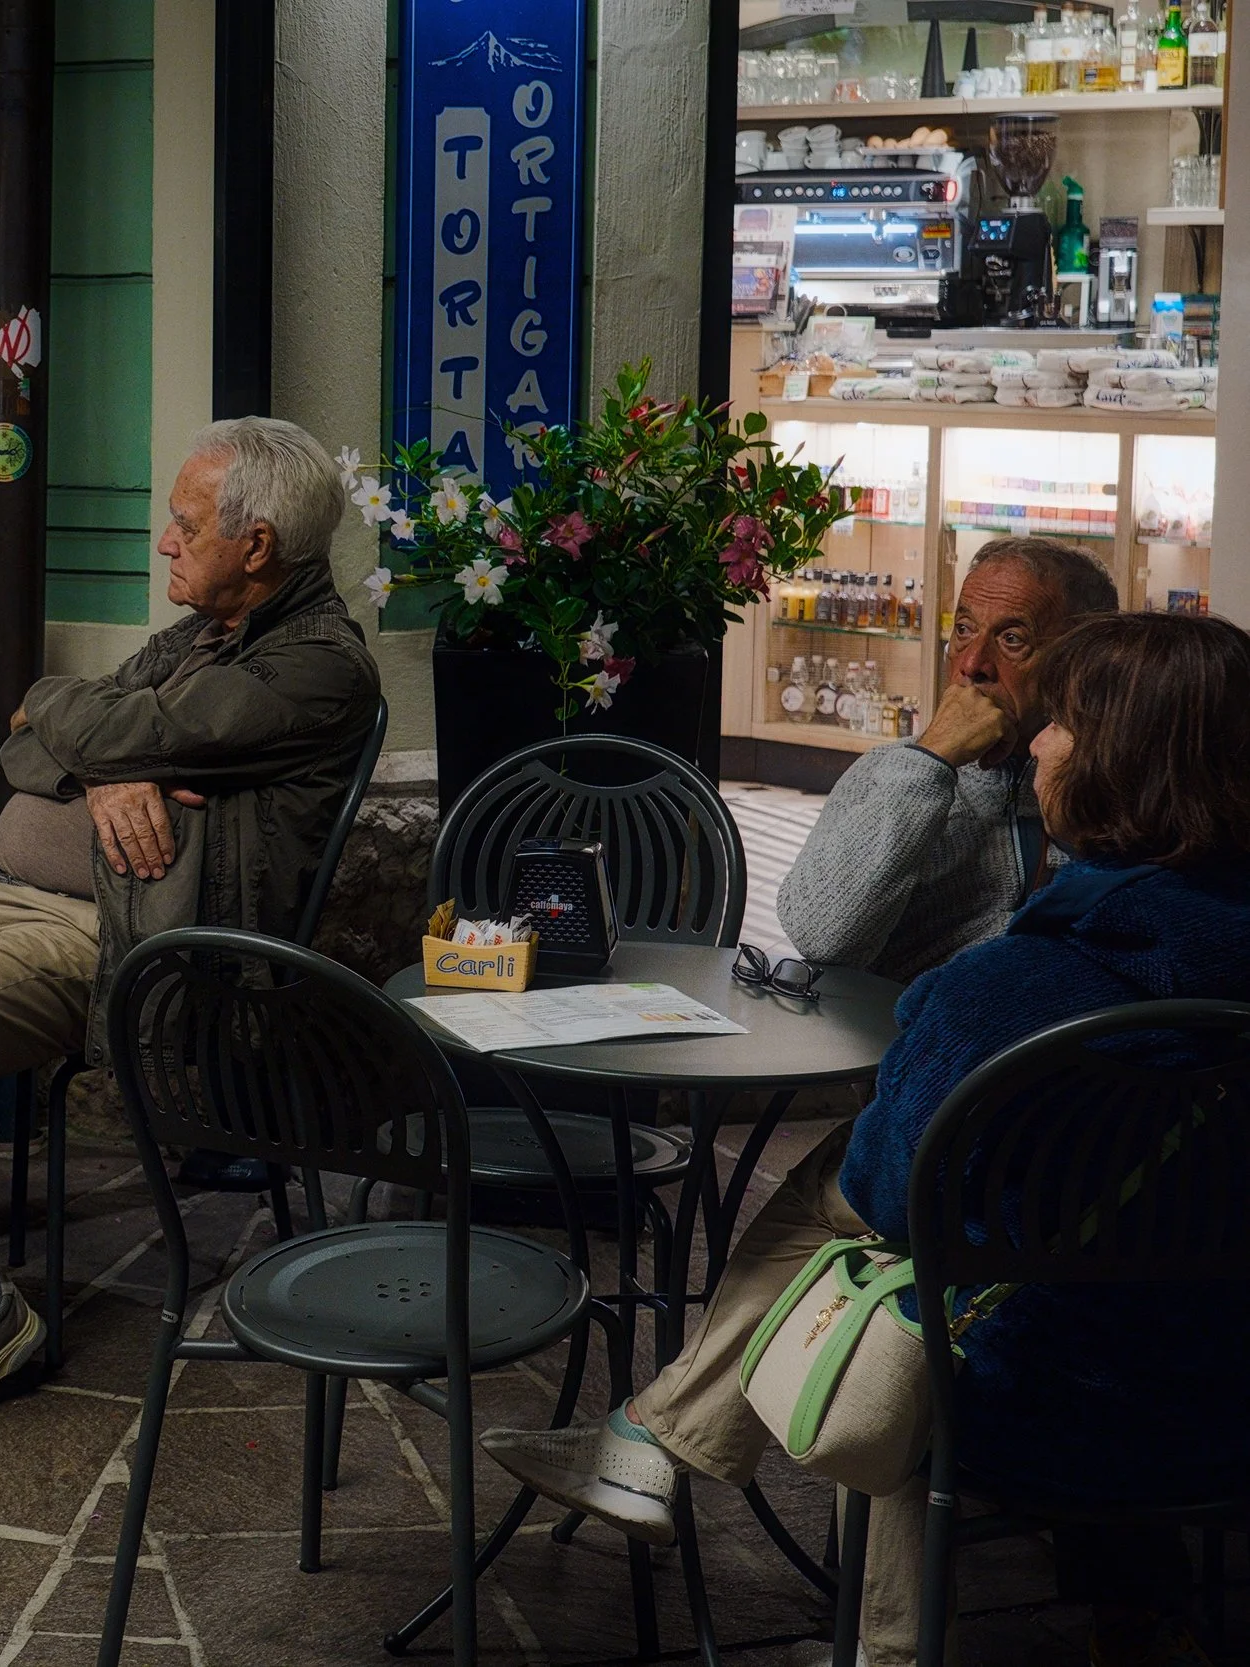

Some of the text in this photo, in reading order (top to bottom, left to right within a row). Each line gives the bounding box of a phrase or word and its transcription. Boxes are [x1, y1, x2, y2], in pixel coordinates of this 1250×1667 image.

[438, 135, 484, 473] TORTA
[505, 79, 555, 497] ORTIGAR
[436, 952, 515, 977] Carli
